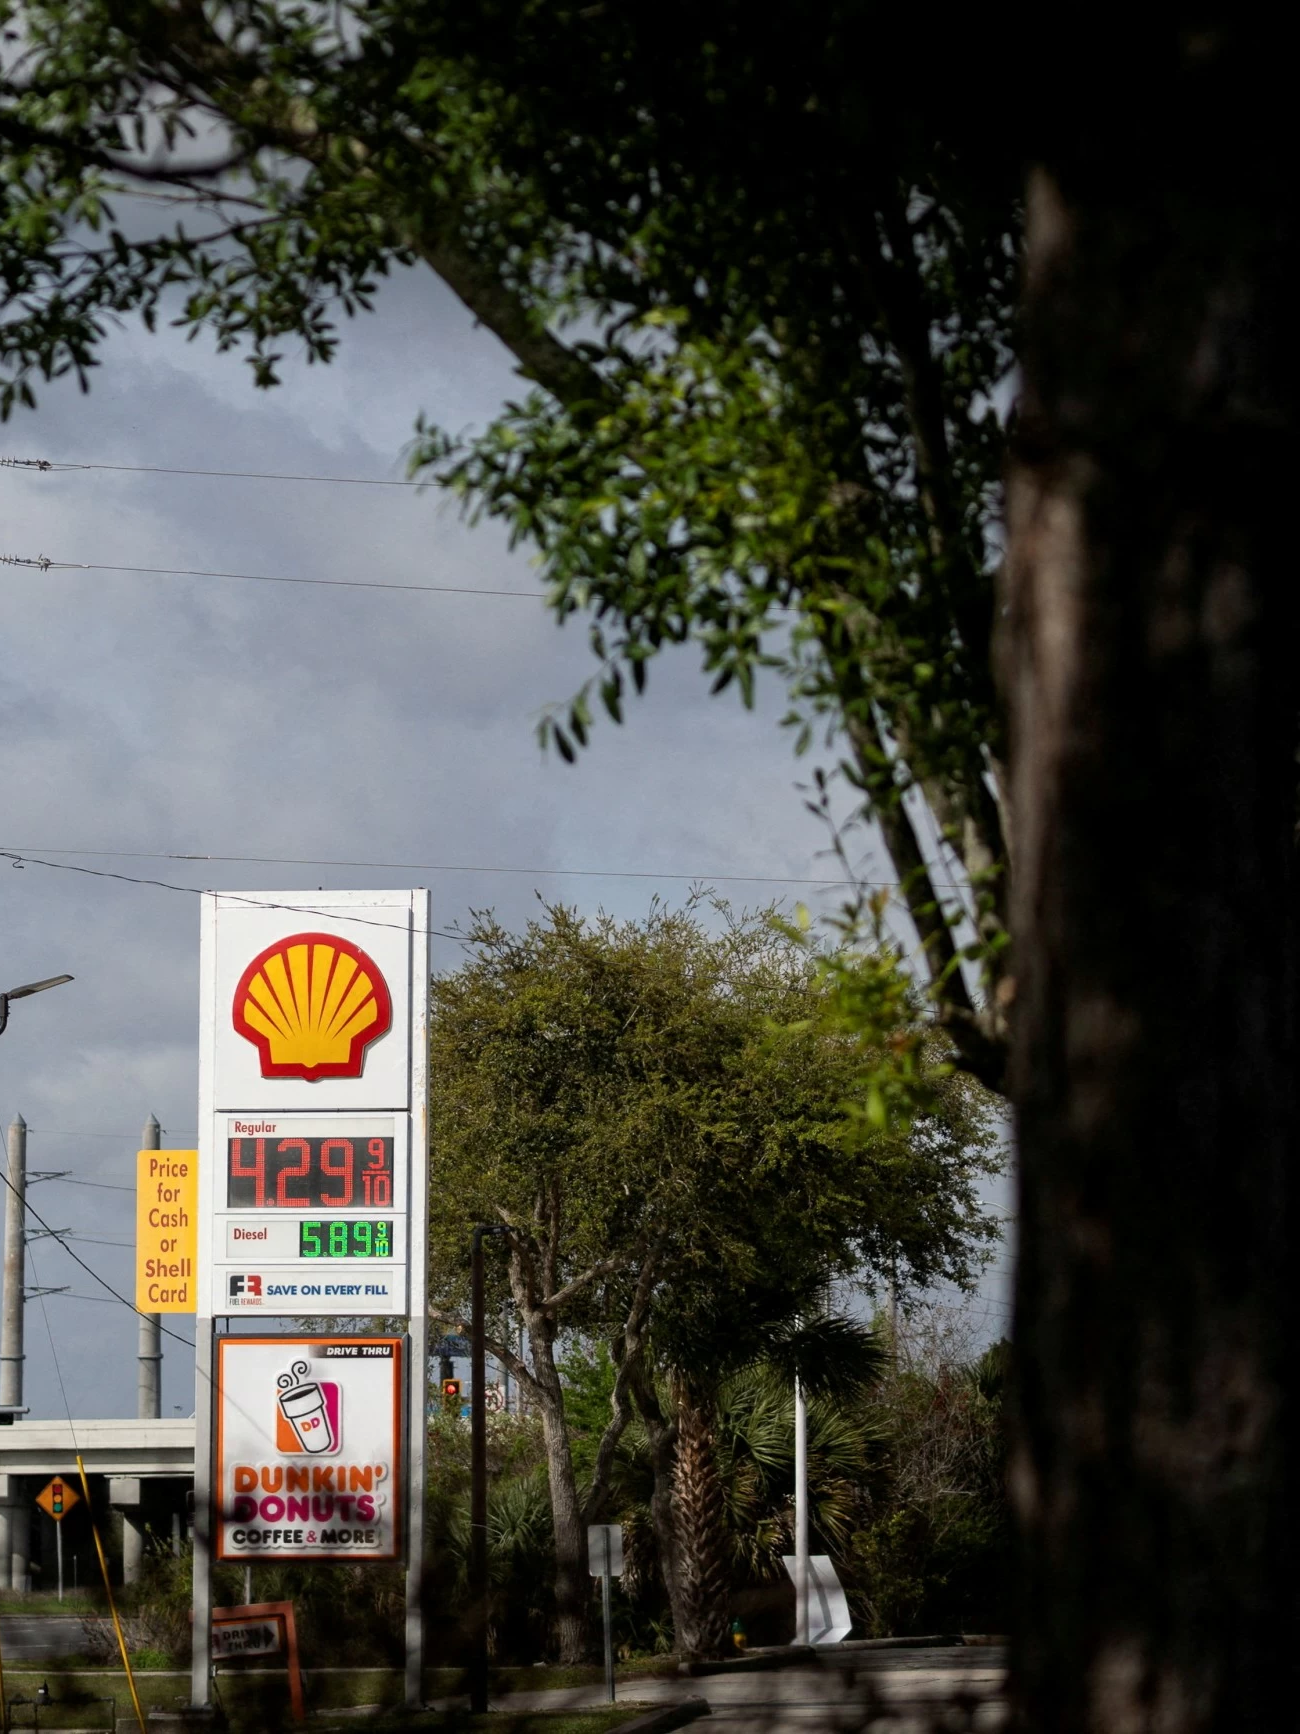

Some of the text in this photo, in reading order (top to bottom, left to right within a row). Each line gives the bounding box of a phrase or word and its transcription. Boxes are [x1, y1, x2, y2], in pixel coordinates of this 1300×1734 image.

[234, 1121, 276, 1135] Regular
[149, 1158, 188, 1177] Price
[157, 1182, 180, 1202] for
[148, 1207, 189, 1227] Cash
[233, 1228, 267, 1240] Diesel
[160, 1239, 177, 1252] or
[145, 1258, 191, 1277] Shell
[148, 1283, 187, 1303] Card
[267, 1285, 388, 1295] SAVE ON EVERY FILL
[327, 1347, 390, 1356] DRIVE THRU
[234, 1465, 383, 1493] DUNKIN'
[233, 1495, 375, 1523] DONUTS
[232, 1529, 375, 1544] COFFEE & MORE
